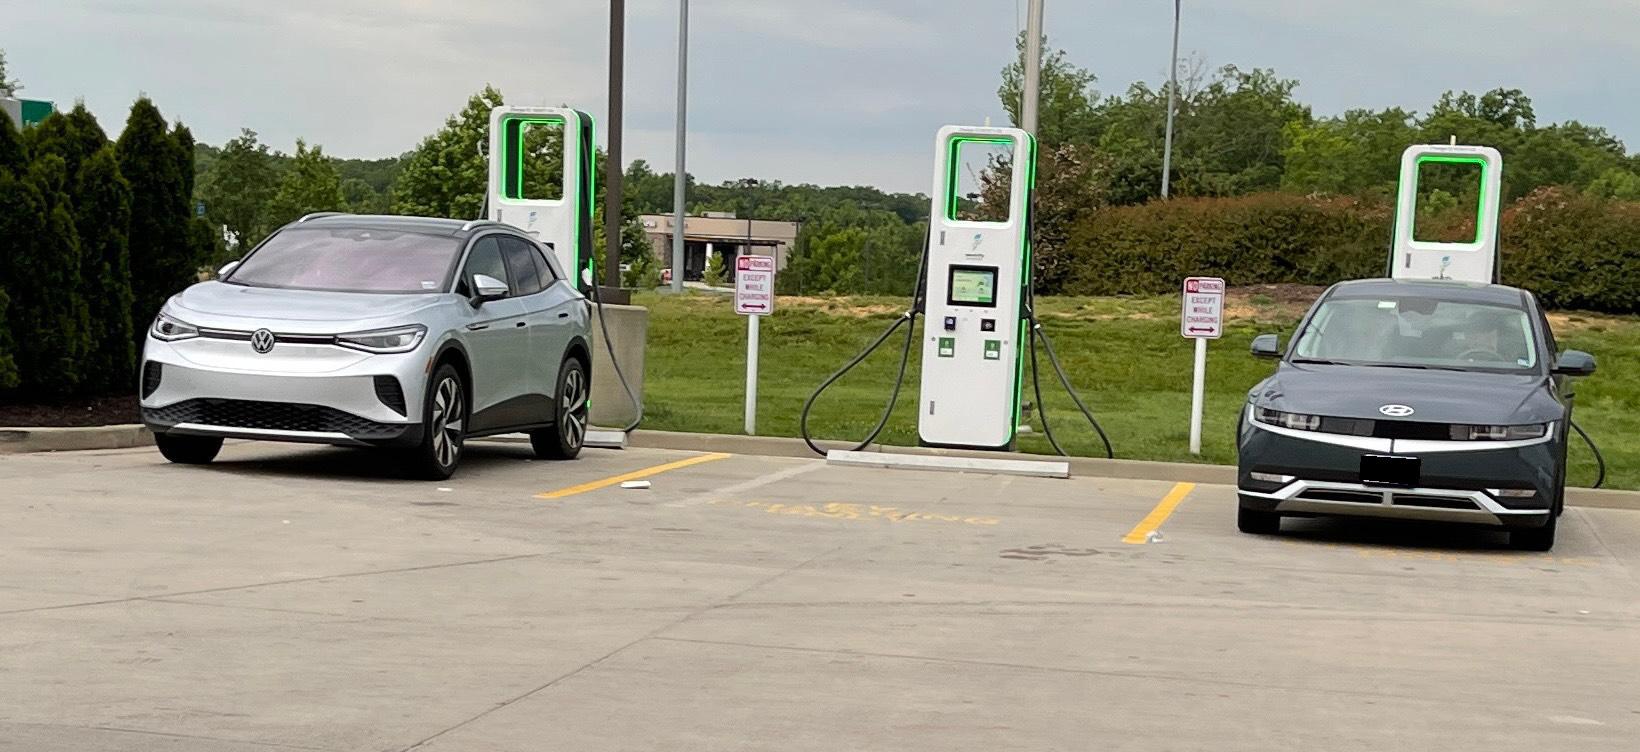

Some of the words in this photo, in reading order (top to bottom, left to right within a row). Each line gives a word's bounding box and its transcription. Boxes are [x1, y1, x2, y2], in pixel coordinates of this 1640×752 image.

[743, 273, 767, 281] EXCEPT
[745, 283, 764, 291] WHILE
[739, 293, 769, 301] CHARGING
[1191, 296, 1216, 304] EXCEPT
[1193, 306, 1213, 314] WHILE
[1187, 315, 1217, 323] CHARGING
